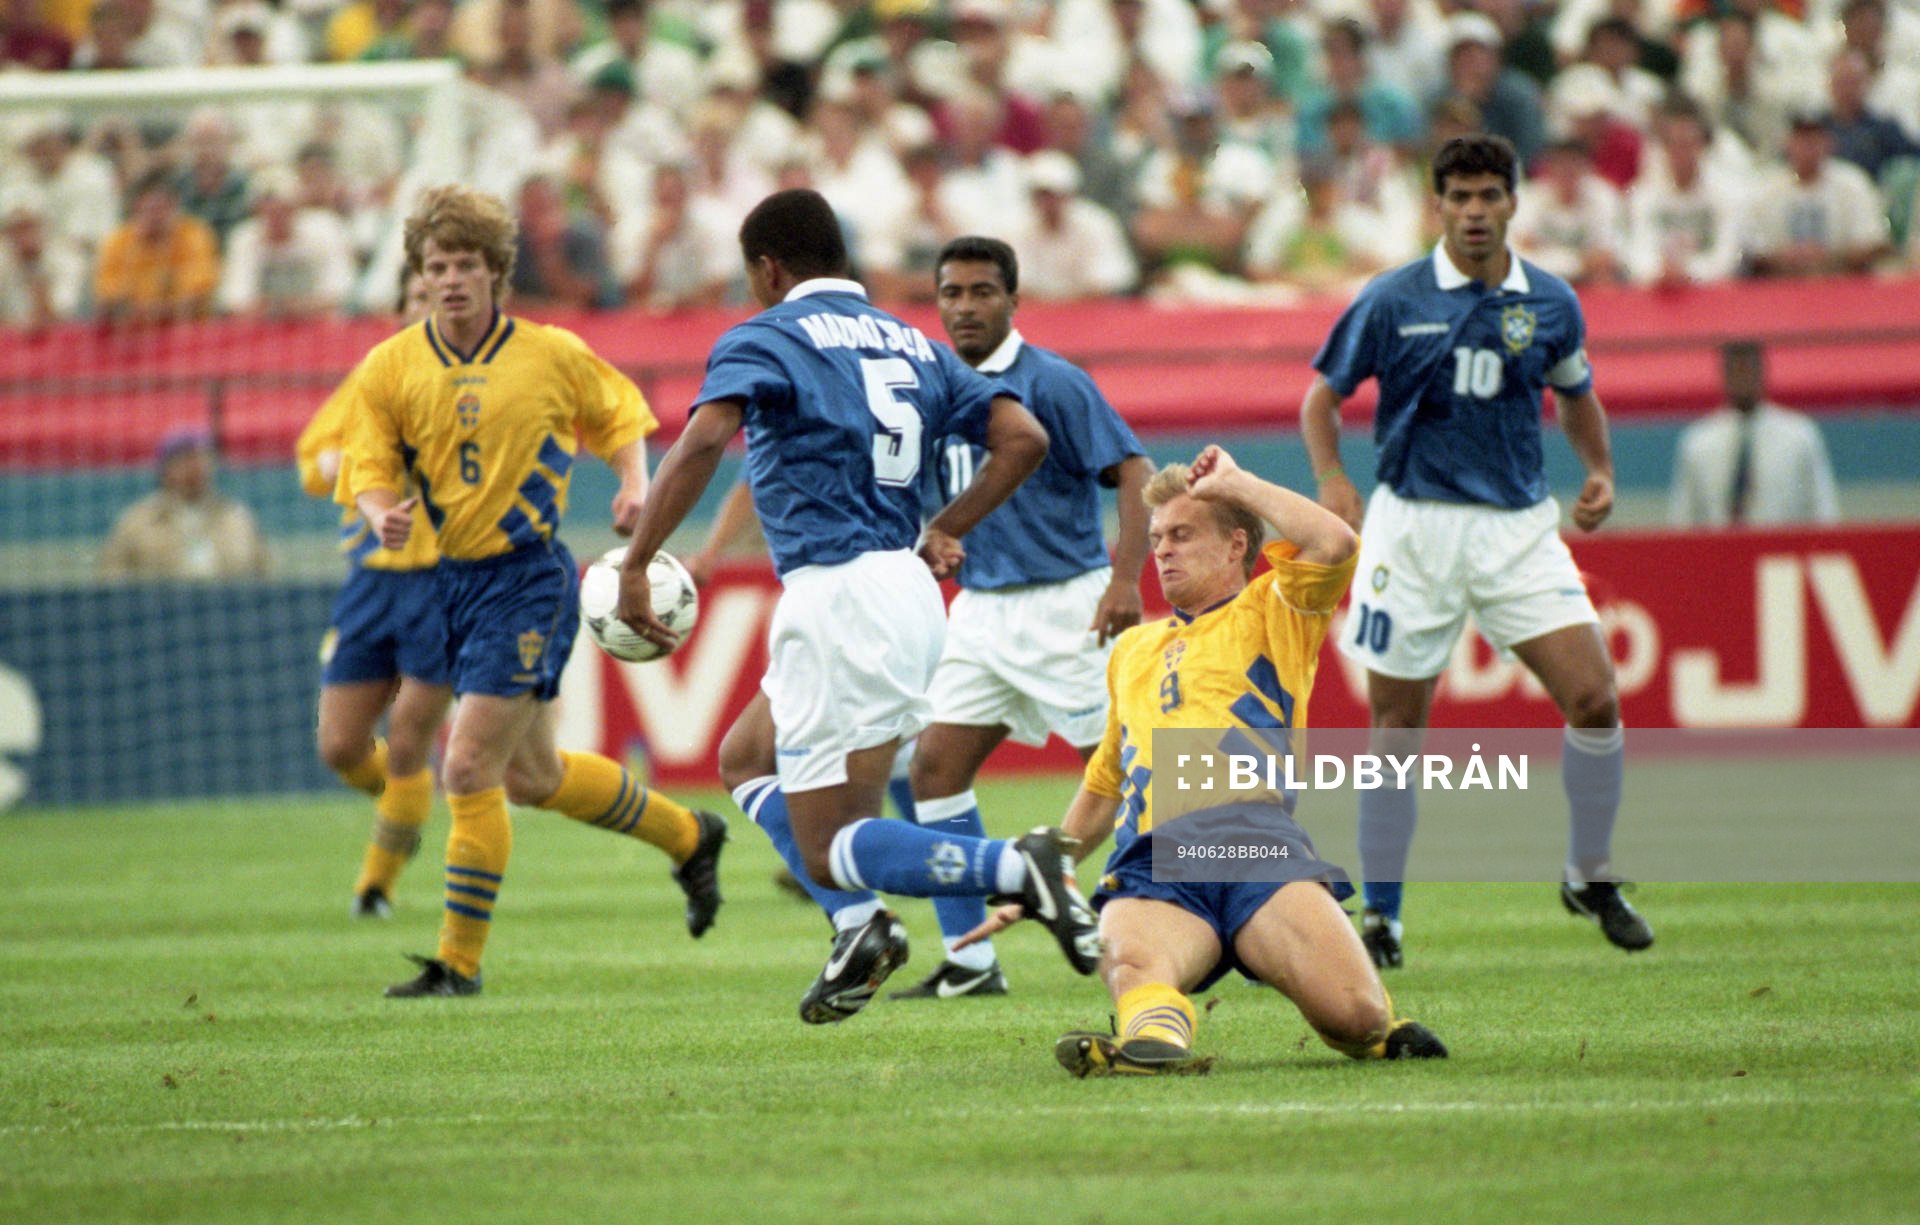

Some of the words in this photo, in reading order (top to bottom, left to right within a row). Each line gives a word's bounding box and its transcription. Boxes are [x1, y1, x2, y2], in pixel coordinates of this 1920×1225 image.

[1453, 346, 1503, 398] 10
[859, 358, 923, 487] 5
[459, 441, 480, 485] 6
[946, 443, 973, 495] 11
[1355, 603, 1393, 656] 10
[1160, 670, 1181, 714] 9
